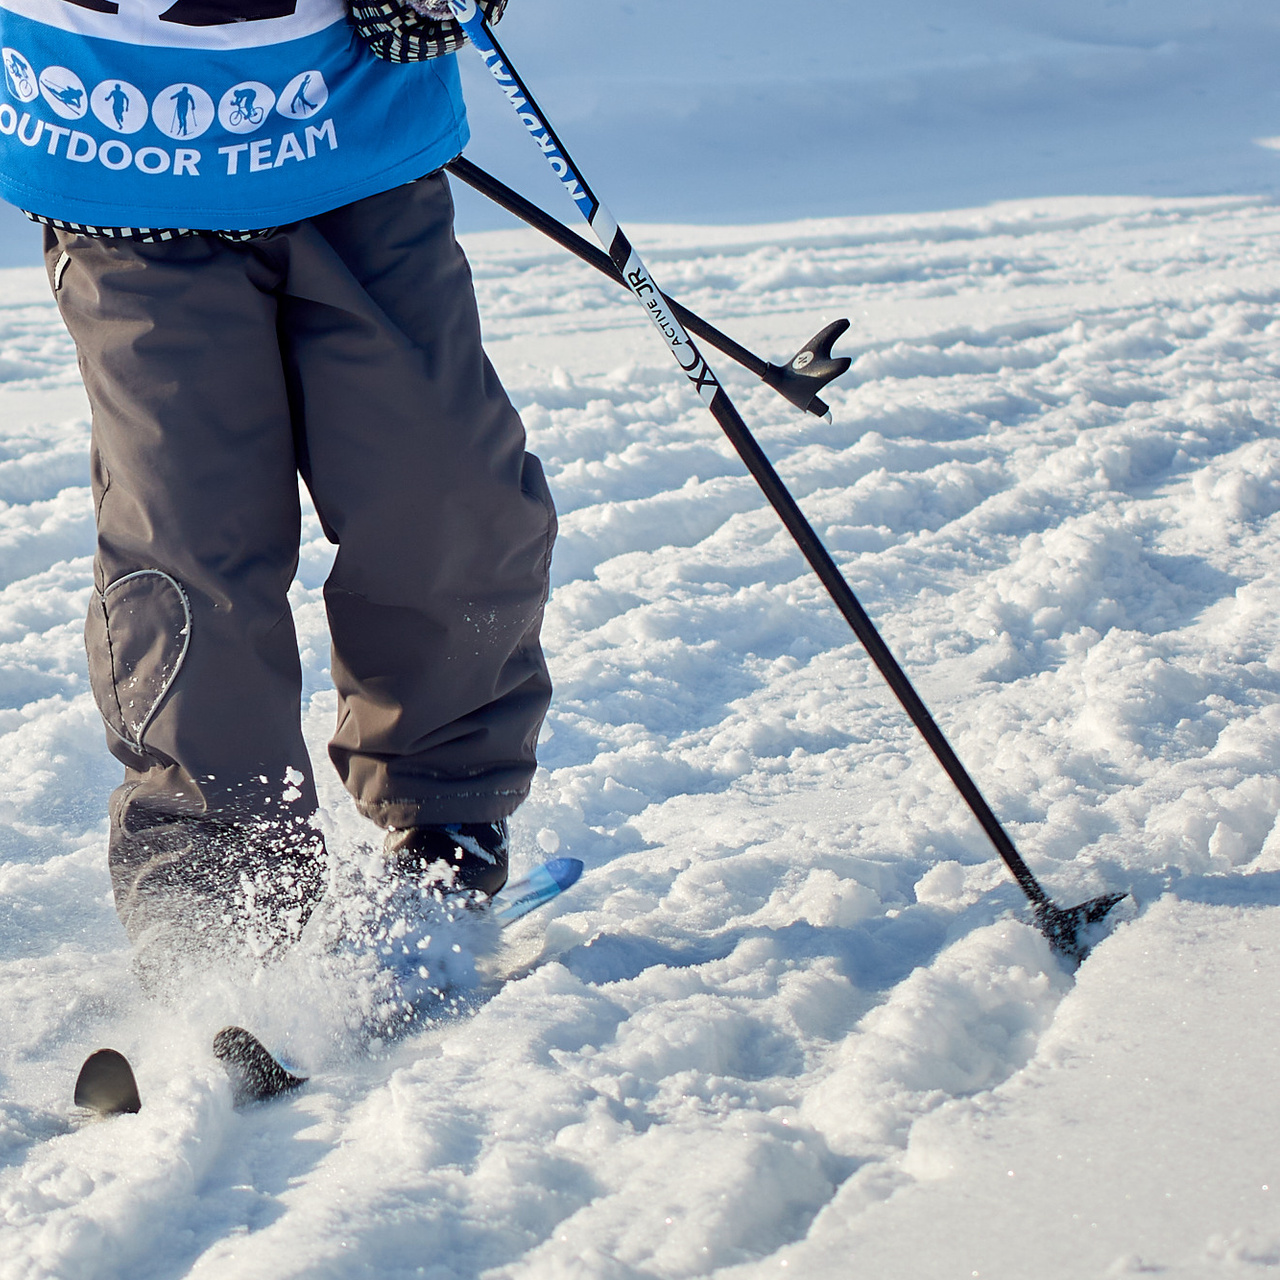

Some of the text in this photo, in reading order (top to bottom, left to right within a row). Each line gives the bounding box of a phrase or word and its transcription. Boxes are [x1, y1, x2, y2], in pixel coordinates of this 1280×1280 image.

[218, 118, 339, 176] TEAM
[477, 48, 587, 201] NORDWAY
[627, 267, 654, 297] JR
[646, 298, 683, 346] ACTIVE
